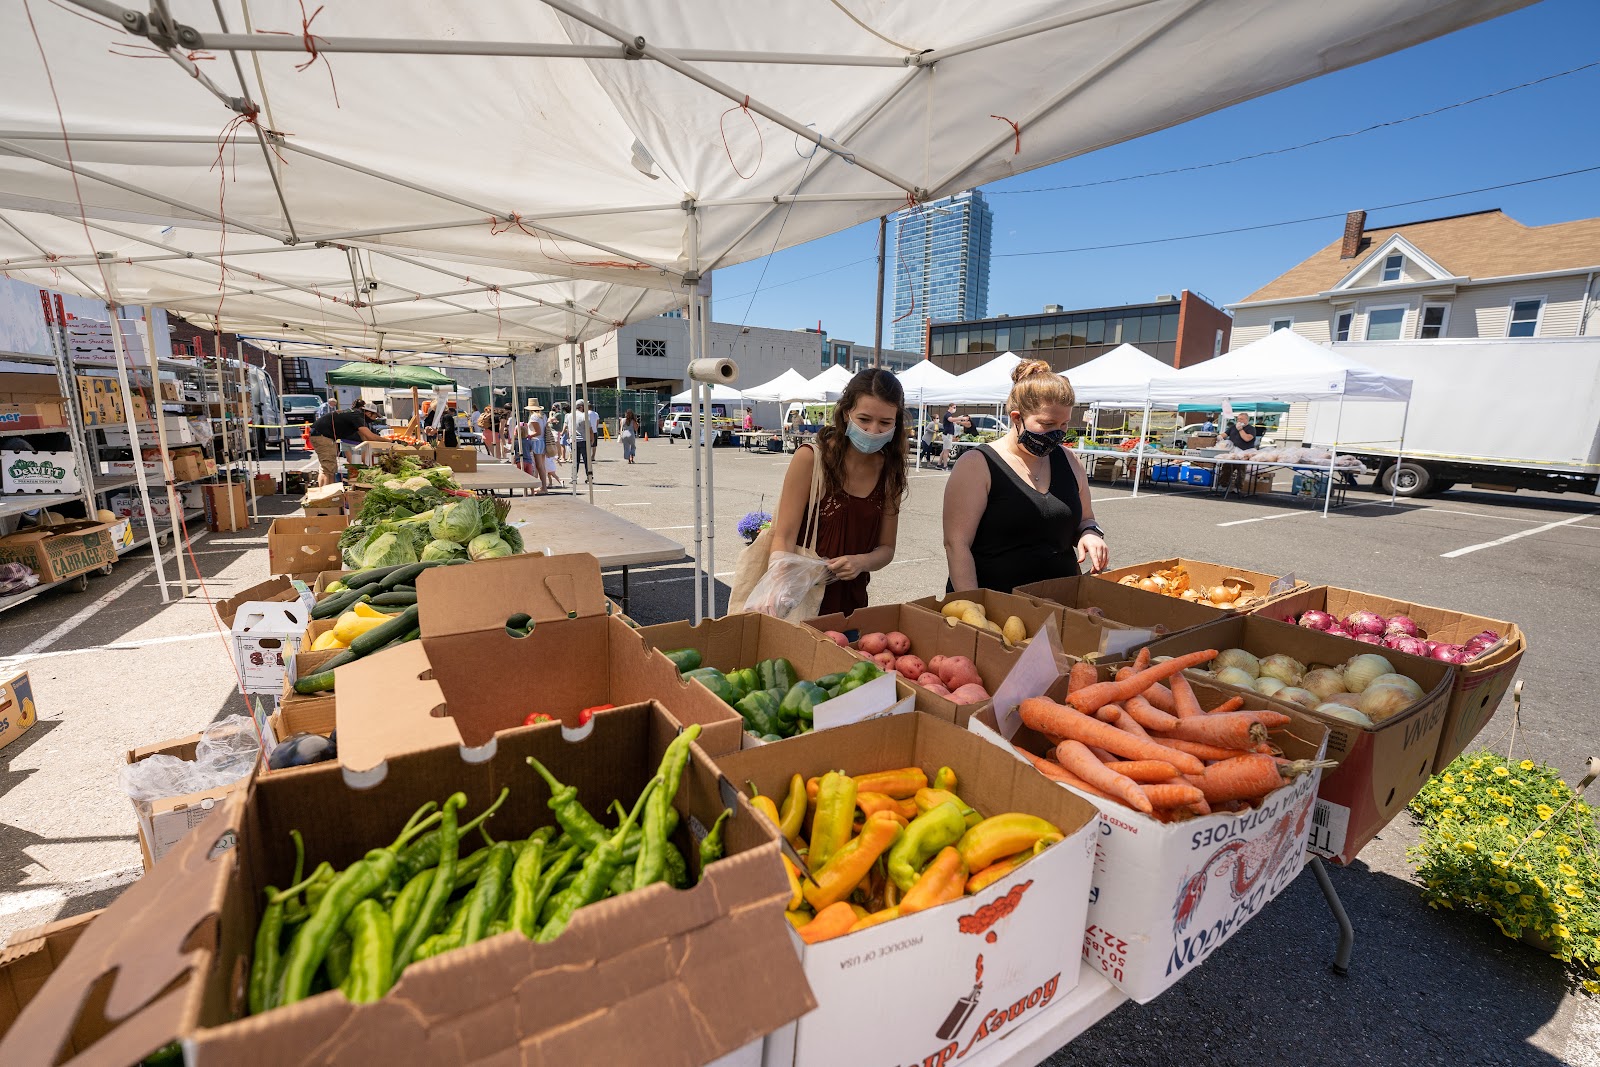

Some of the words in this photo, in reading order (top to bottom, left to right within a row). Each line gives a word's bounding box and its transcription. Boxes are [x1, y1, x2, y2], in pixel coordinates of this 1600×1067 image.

[13, 466, 62, 477] DeWITT
[52, 547, 102, 577] CABBAGE
[1110, 816, 1138, 835] PACKED
[1191, 806, 1279, 851] POTATOES
[1269, 842, 1304, 896] RED
[1165, 880, 1267, 977] DRAGON
[878, 935, 924, 959] PRODUCE
[1085, 937, 1106, 957] LBS
[839, 956, 862, 971] USA
[861, 952, 878, 965] OF
[1109, 952, 1126, 968] 50
